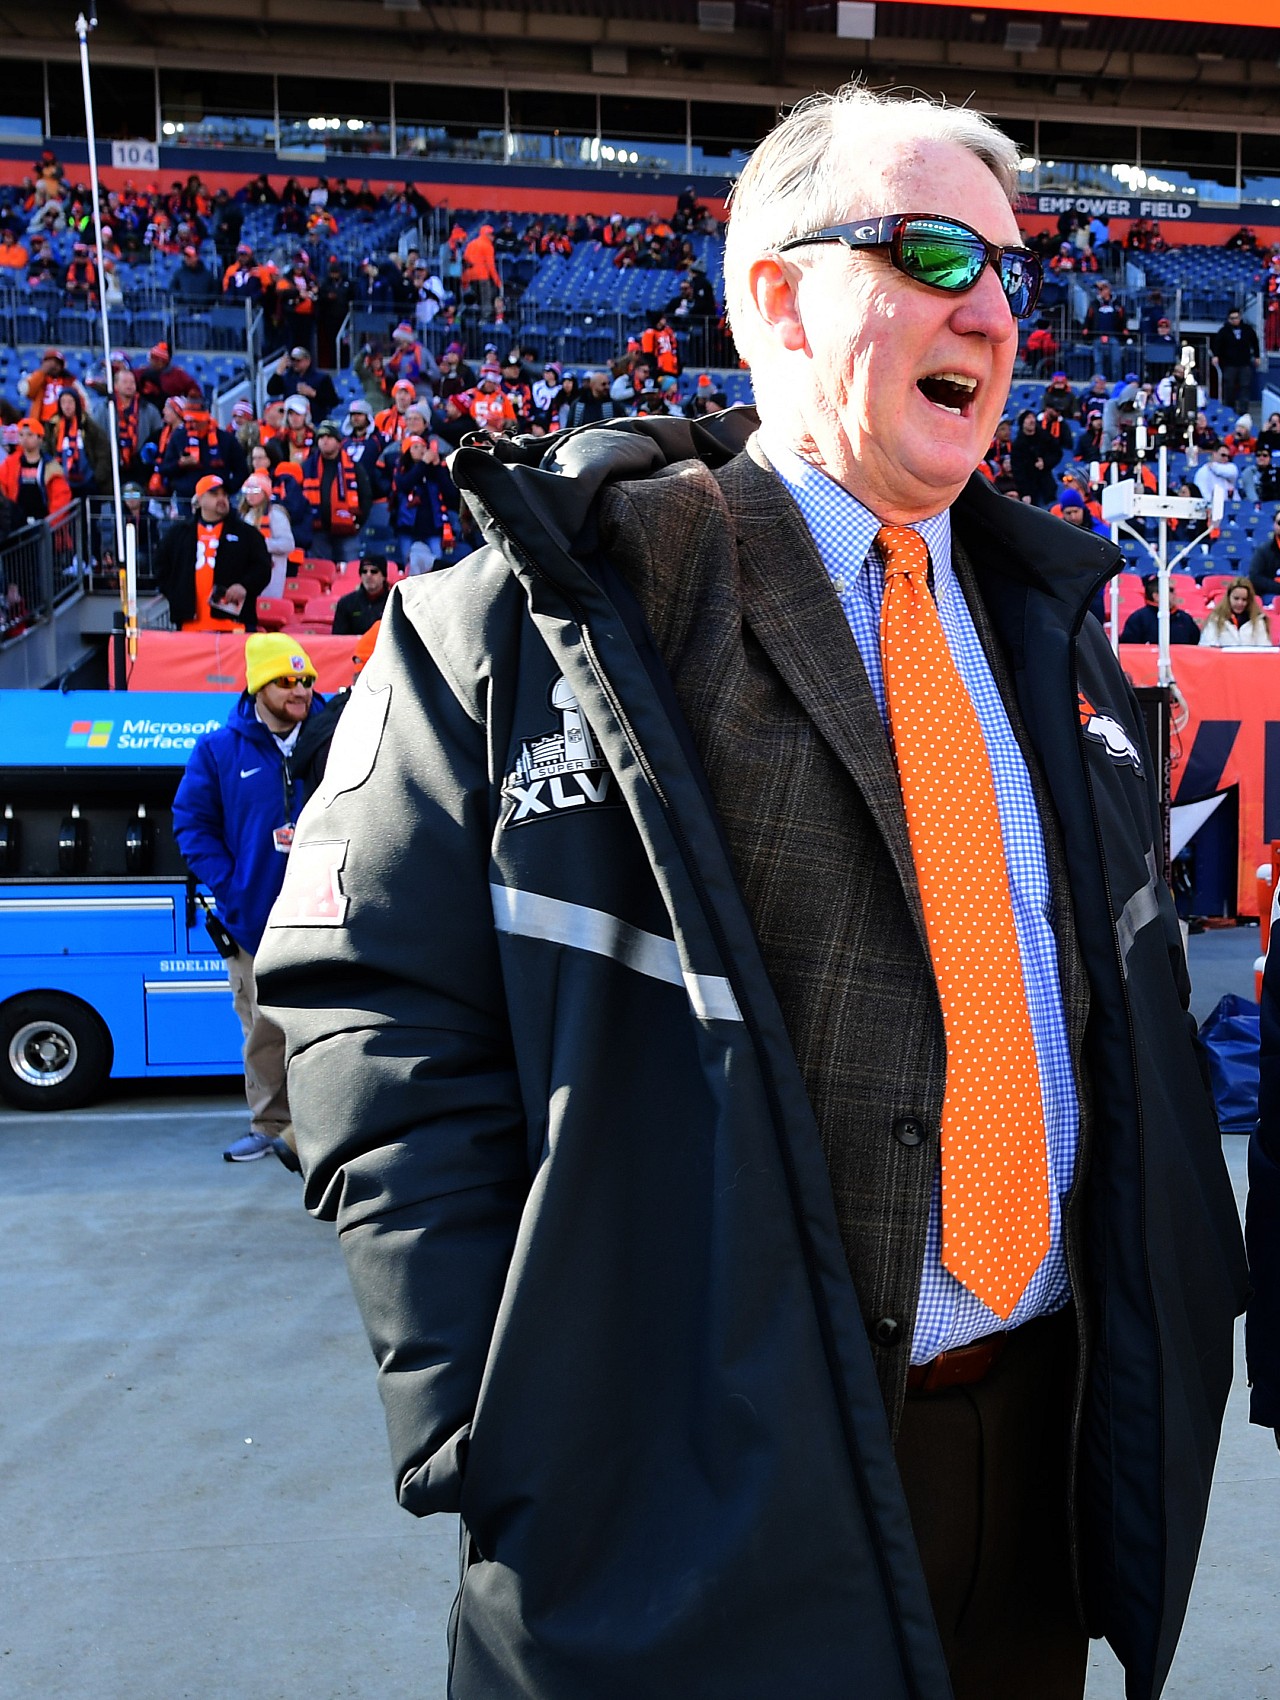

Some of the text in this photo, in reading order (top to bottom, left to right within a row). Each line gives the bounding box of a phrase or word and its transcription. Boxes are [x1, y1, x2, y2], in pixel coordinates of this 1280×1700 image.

[118, 145, 154, 163] 104
[1139, 200, 1192, 219] FIELD
[122, 719, 221, 735] Microsoft
[116, 734, 197, 749] Surface
[538, 759, 610, 777] SUPER BO
[508, 772, 625, 821] XLV
